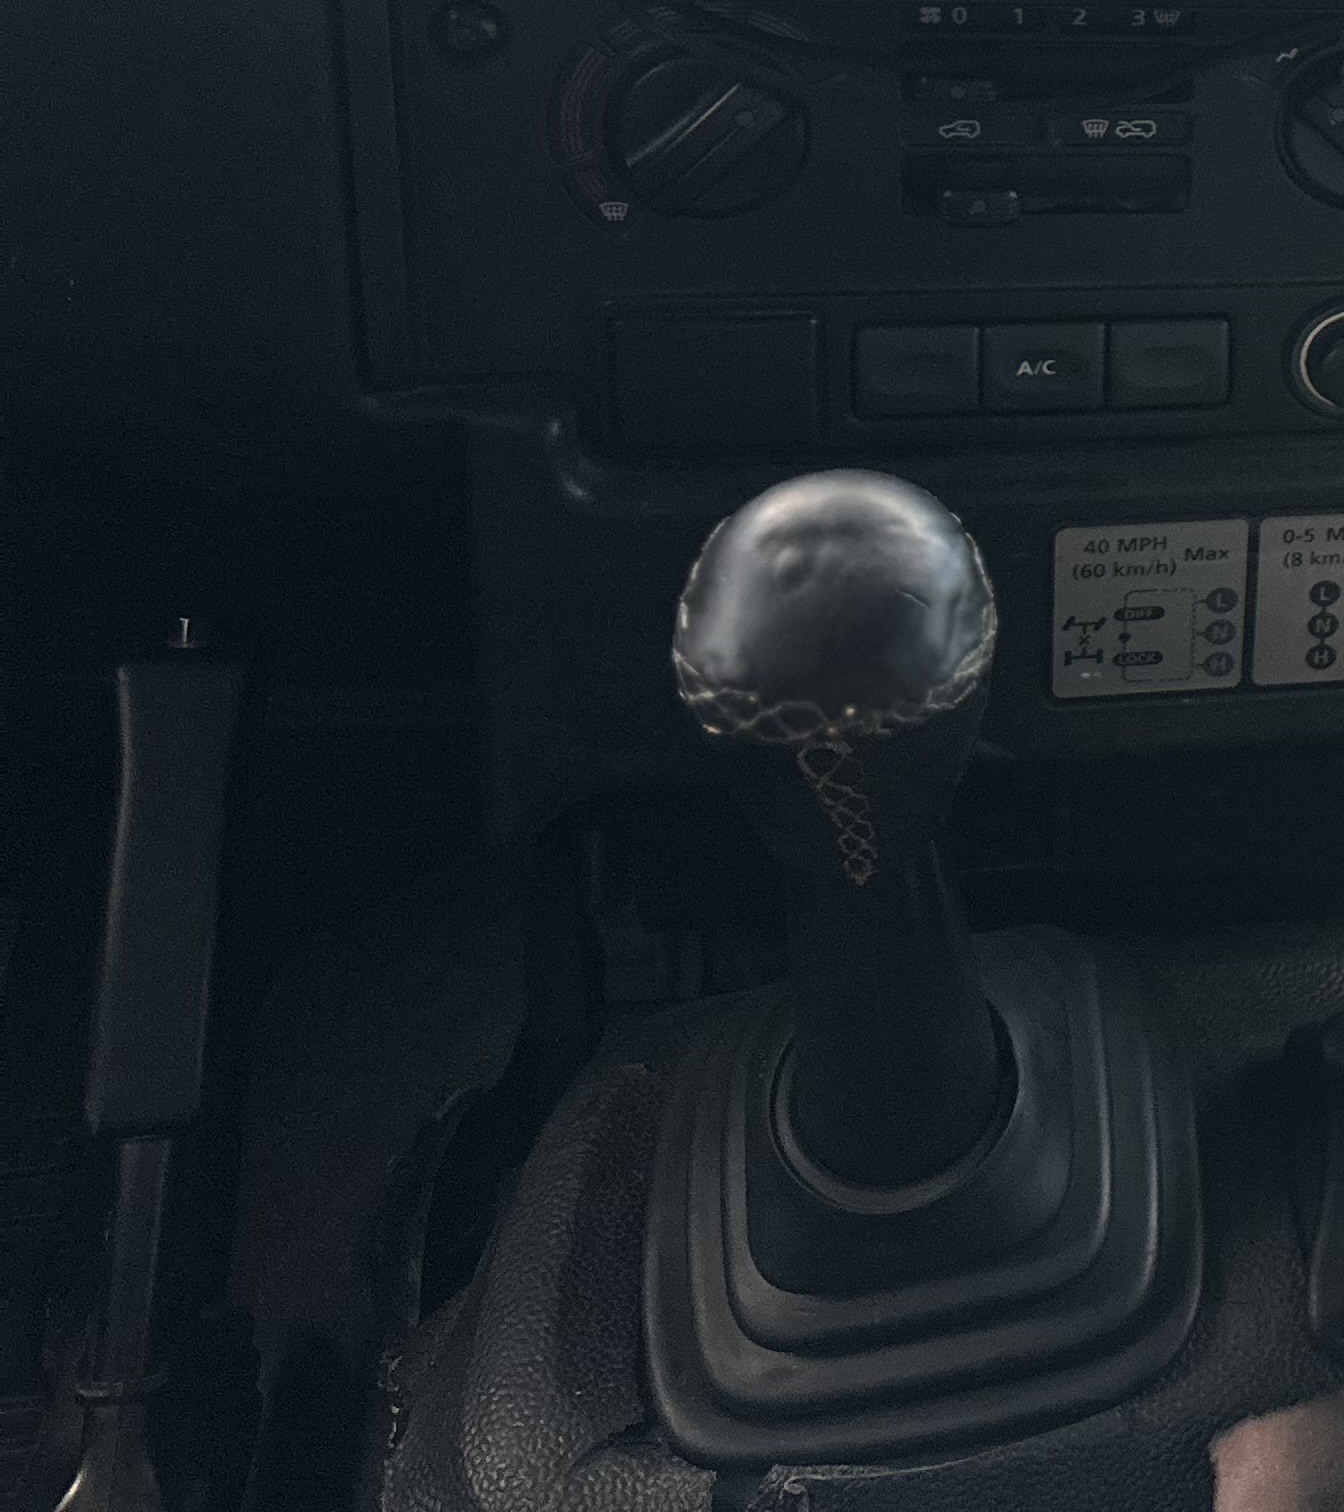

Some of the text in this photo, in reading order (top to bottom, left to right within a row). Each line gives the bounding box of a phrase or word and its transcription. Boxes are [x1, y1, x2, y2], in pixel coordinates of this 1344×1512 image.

[1013, 7, 1025, 25] 1
[1071, 7, 1088, 26] 2
[1131, 9, 1146, 27] 3
[1016, 358, 1057, 376] A/C
[1083, 535, 1168, 555] 40 MPH
[1282, 527, 1316, 545] 0-5
[1184, 546, 1230, 562] Max
[1283, 551, 1304, 569] (8
[1072, 558, 1178, 581] (60 km/h)
[1318, 586, 1330, 602] L
[1312, 649, 1330, 665] H
